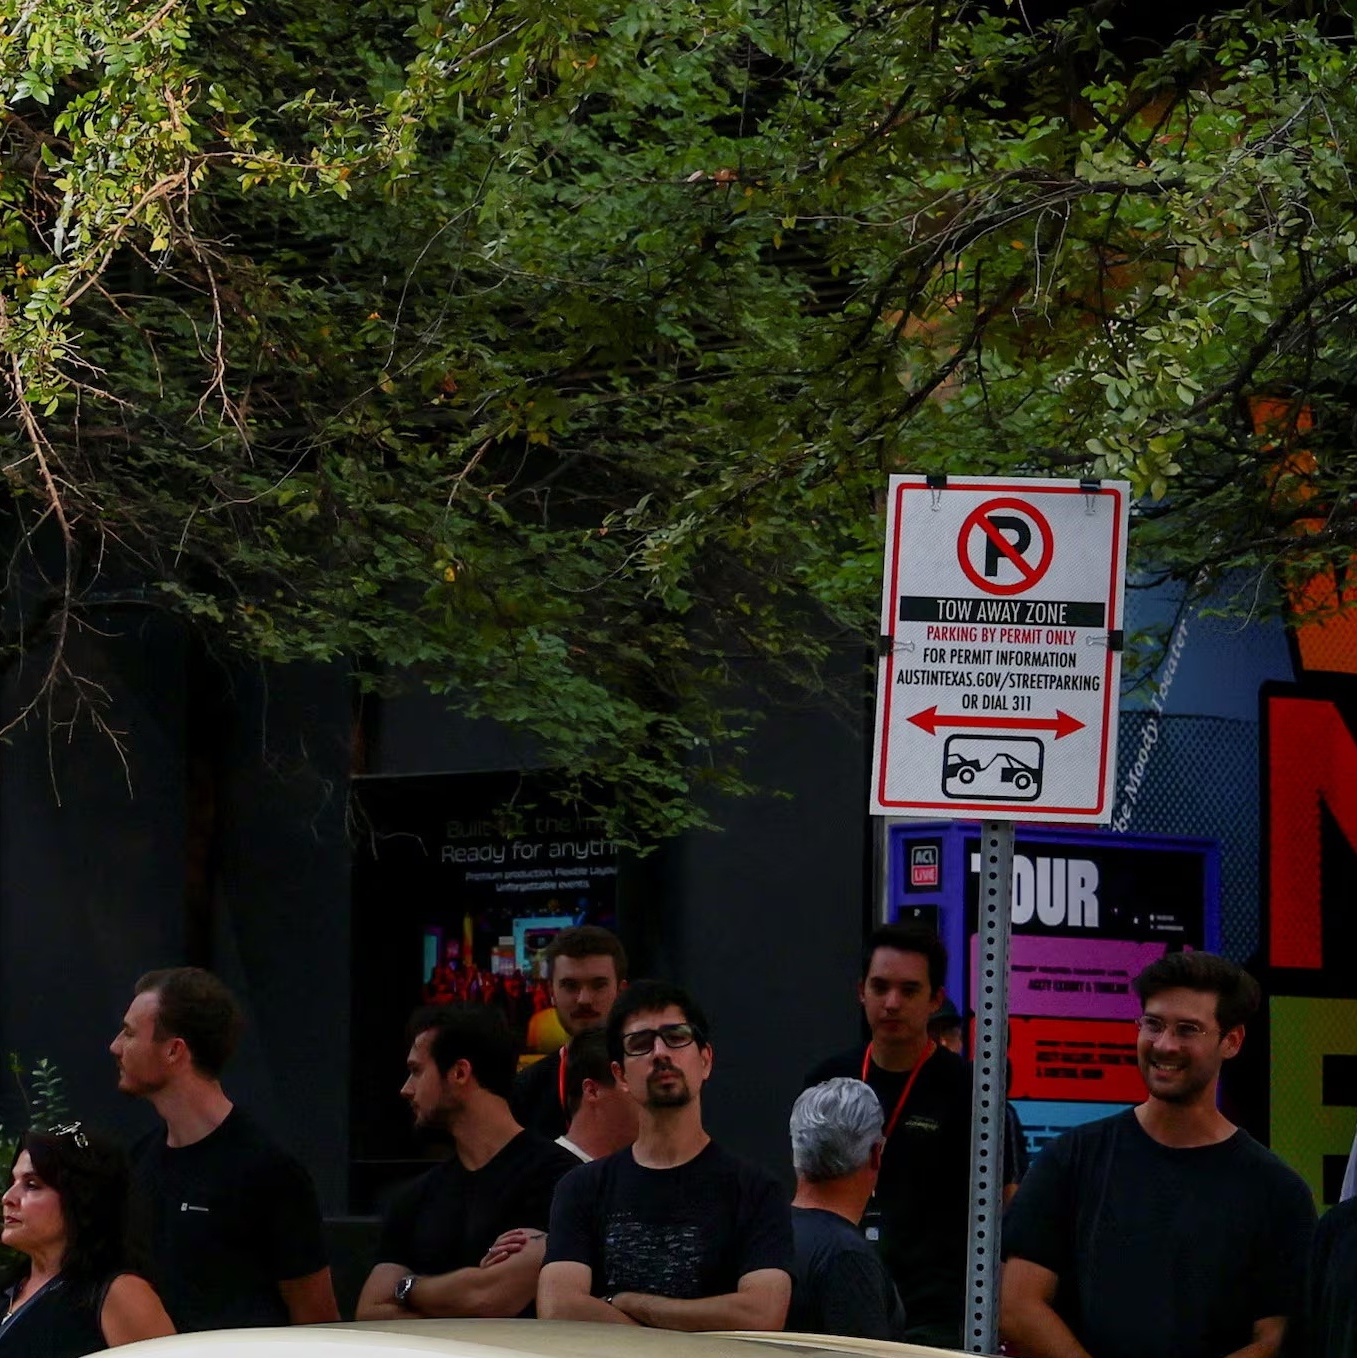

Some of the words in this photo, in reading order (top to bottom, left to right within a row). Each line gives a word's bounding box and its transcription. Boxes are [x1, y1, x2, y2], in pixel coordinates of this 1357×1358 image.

[937, 599, 971, 621] TOW
[977, 601, 1022, 623] AWAY
[1025, 603, 1068, 625] ZONE
[927, 626, 979, 642] PARKING
[981, 627, 997, 643] BY
[999, 628, 1042, 644] PERMIT
[1045, 629, 1076, 645] ONLY
[923, 650, 946, 665] FOR
[950, 650, 993, 666] PERMIT
[996, 651, 1076, 668] INFORMATION
[896, 669, 1100, 692] AUSTINTEXAS.GOV/STREETPARKING
[962, 694, 979, 710] OR
[982, 695, 1009, 711] DIAL
[1012, 695, 1032, 711] 311
[441, 844, 506, 863] Ready
[512, 841, 543, 860] for
[915, 850, 934, 864] ACL
[971, 853, 1099, 928] OUR
